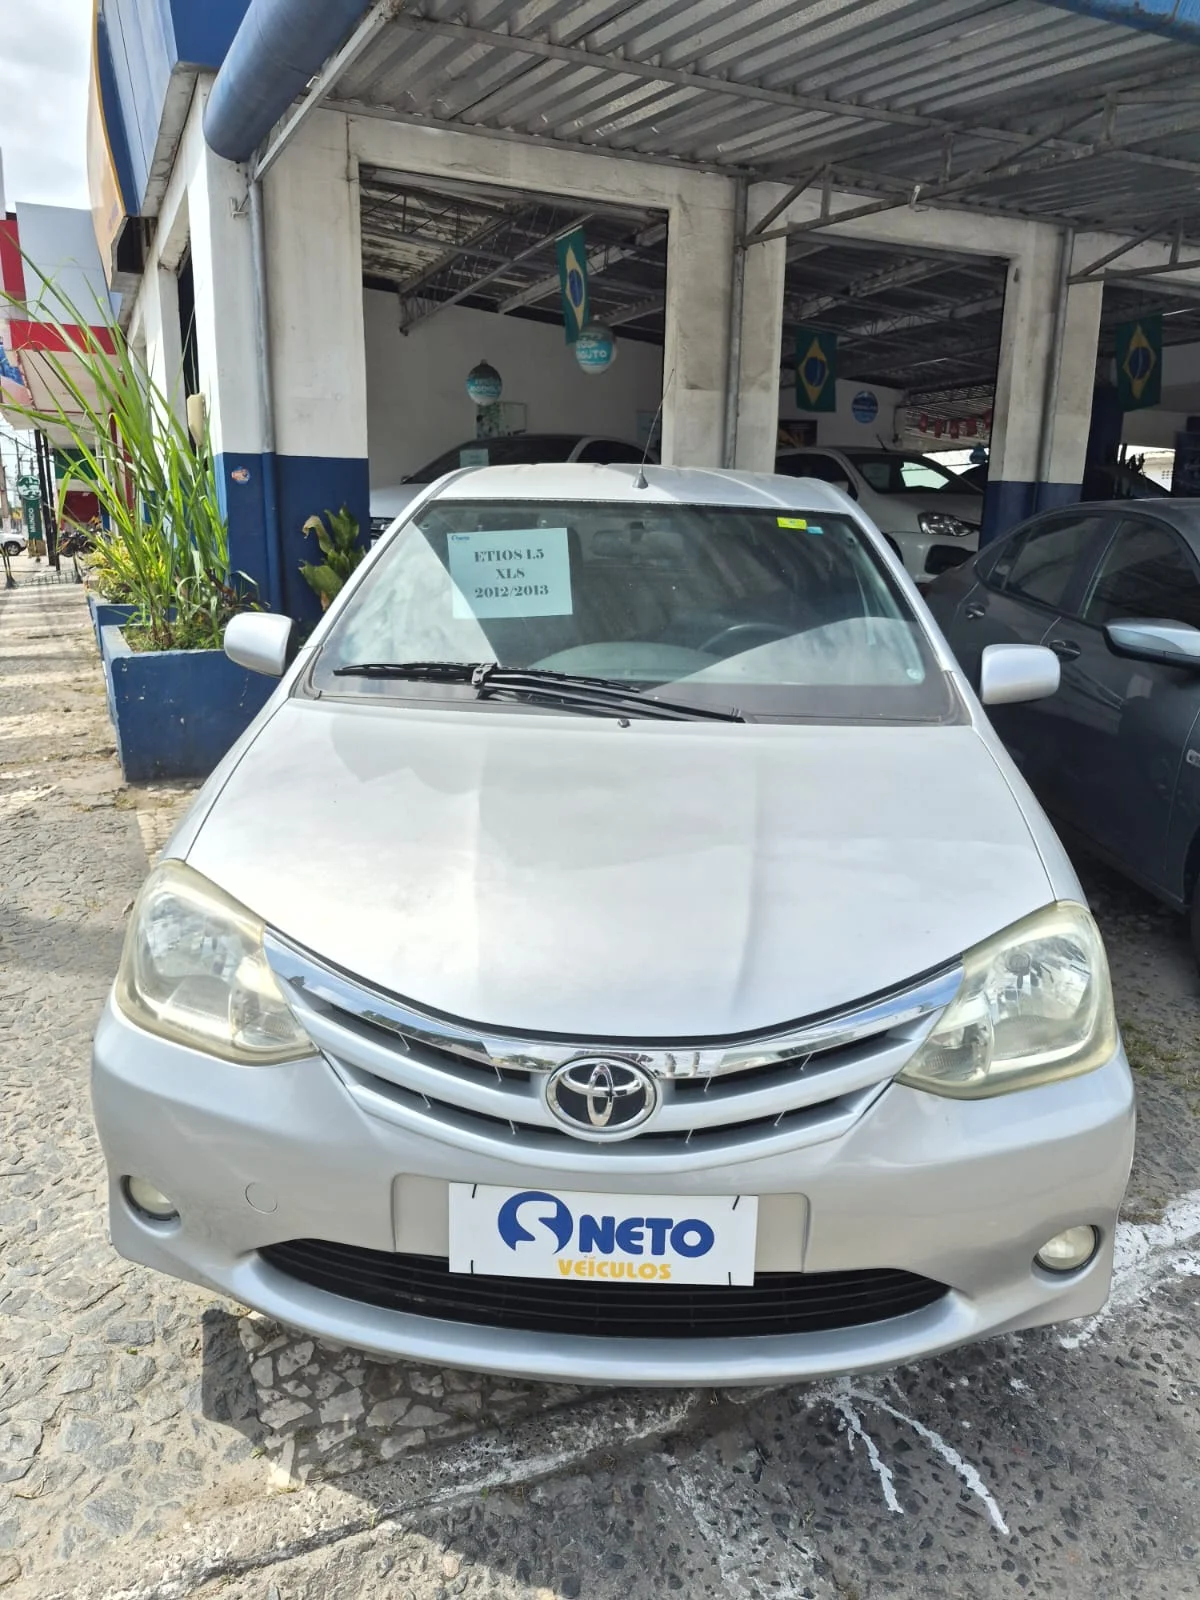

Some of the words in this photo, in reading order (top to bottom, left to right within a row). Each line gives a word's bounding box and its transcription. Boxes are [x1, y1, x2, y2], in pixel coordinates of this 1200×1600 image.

[474, 549, 523, 563] ETIOS
[526, 548, 545, 560] 1.5
[496, 568, 525, 580] XLS
[474, 584, 549, 599] 2012/2013
[578, 1214, 715, 1258] NETO
[557, 1256, 672, 1280] VEÍCULOS
